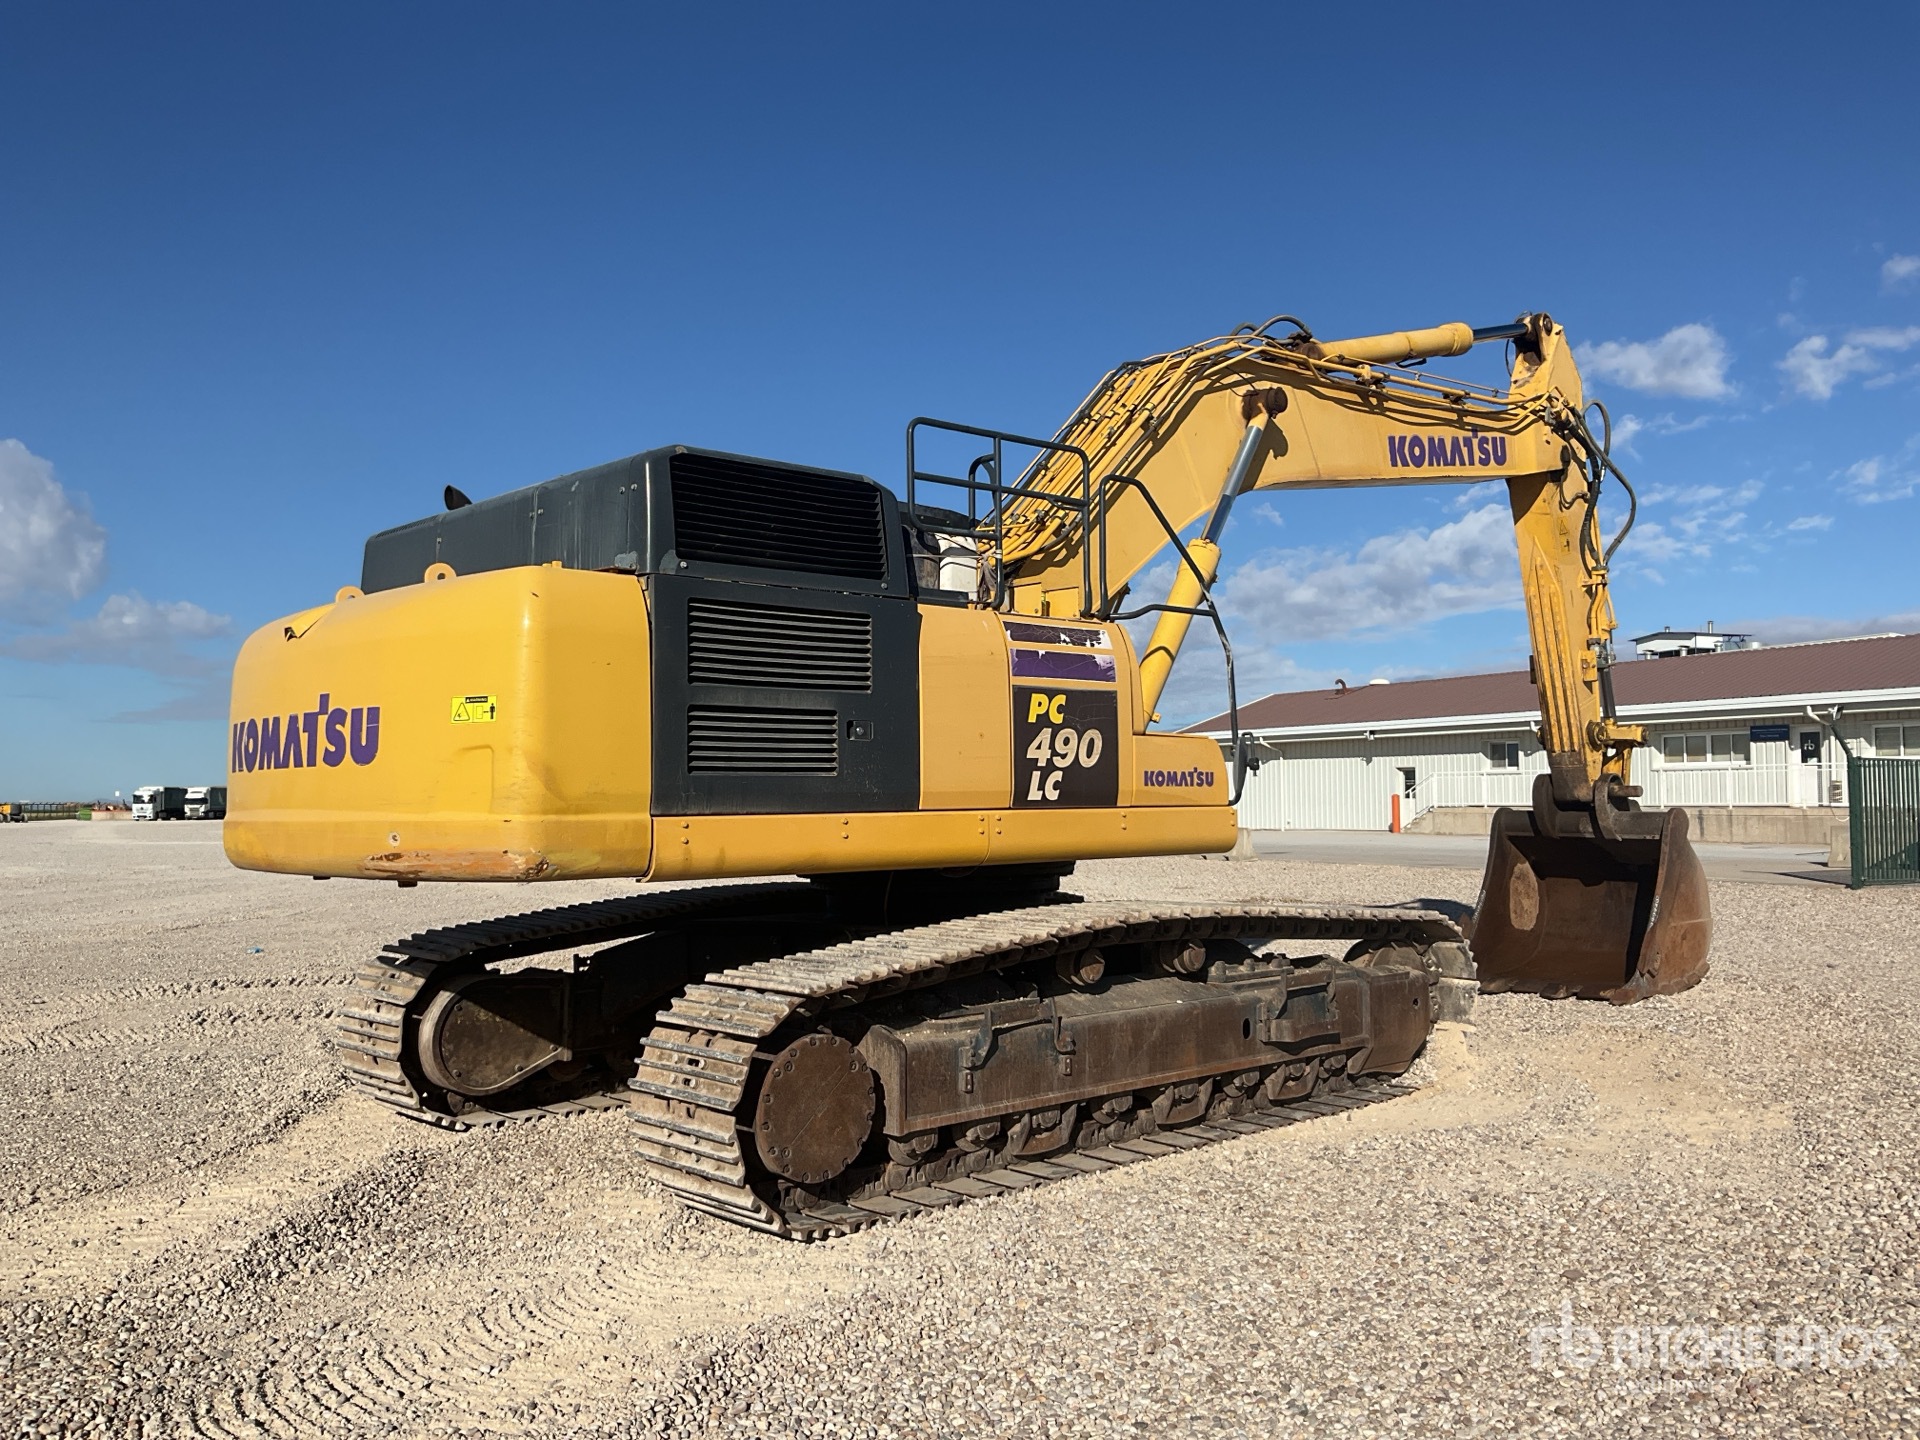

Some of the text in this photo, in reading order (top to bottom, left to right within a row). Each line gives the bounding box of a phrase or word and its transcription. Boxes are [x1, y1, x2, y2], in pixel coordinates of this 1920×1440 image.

[1388, 426, 1507, 468] KOMATSU
[1027, 693, 1066, 724] PC
[231, 693, 381, 773] KOMATSU
[1026, 727, 1103, 769] 490
[1027, 770, 1063, 801] LC
[1143, 767, 1214, 787] KOMATSU
